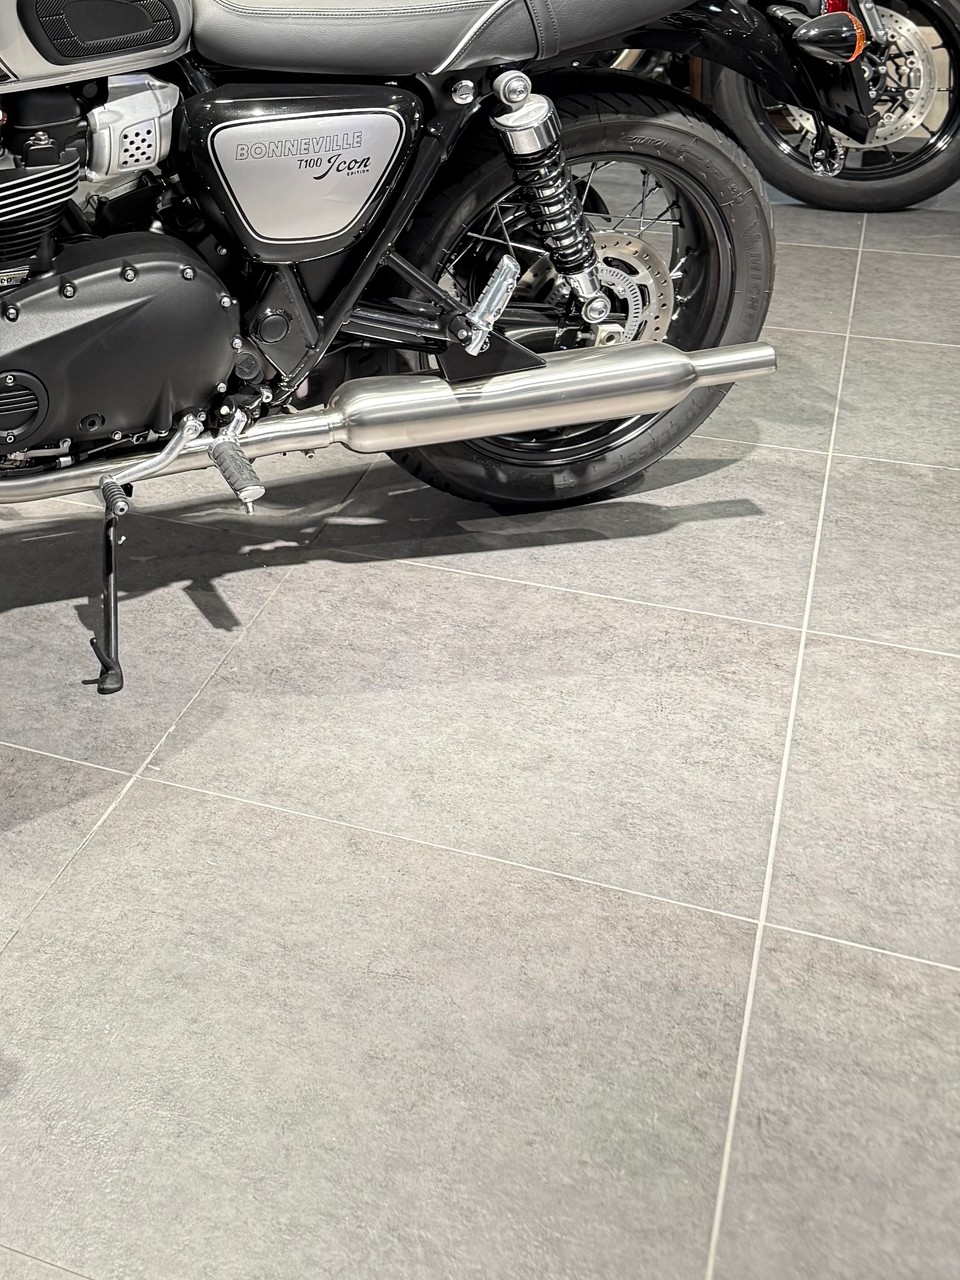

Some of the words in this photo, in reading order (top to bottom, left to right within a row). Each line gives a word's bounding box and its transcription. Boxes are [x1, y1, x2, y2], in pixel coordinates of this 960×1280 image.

[235, 131, 363, 161] BONNEVILLE
[297, 157, 323, 170] T100
[313, 154, 371, 181] Icon
[346, 169, 370, 177] EDITION
